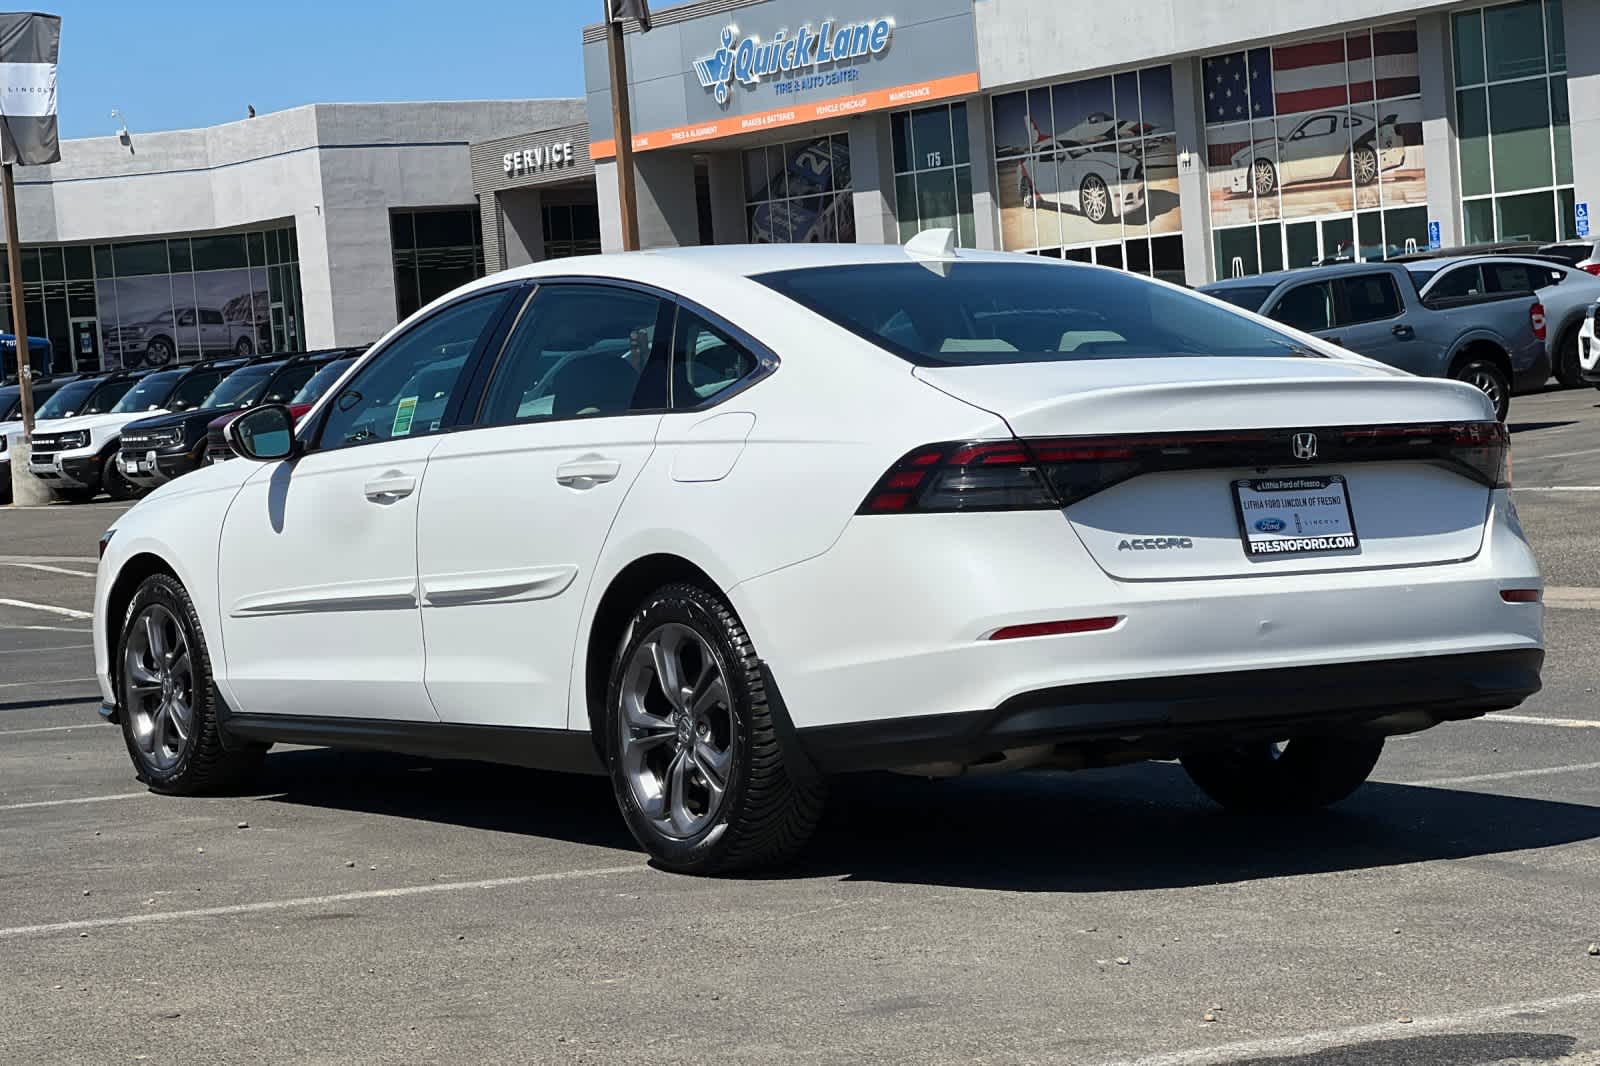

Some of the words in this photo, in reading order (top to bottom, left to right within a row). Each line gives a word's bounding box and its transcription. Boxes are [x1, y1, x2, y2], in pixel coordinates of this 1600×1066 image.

[734, 26, 814, 84] Quick
[815, 19, 889, 65] Lane
[774, 79, 793, 95] TIRE
[794, 79, 801, 92] &
[802, 75, 825, 90] AUTO
[826, 68, 859, 85] CENTER
[503, 142, 573, 171] SERVICE
[926, 152, 941, 167] 175
[1261, 481, 1279, 489] Lithia
[1280, 480, 1293, 488] Ford
[1293, 480, 1300, 488] of
[1300, 479, 1320, 488] Fresno
[1244, 500, 1264, 510] LITHIA
[1265, 499, 1280, 509] FORD
[1281, 498, 1307, 508] LINCOLN
[1308, 497, 1316, 507] OF
[1317, 496, 1341, 506] FRESNO
[1118, 537, 1193, 551] ACCORD
[1250, 536, 1355, 553] FRESNOFORD.COM
